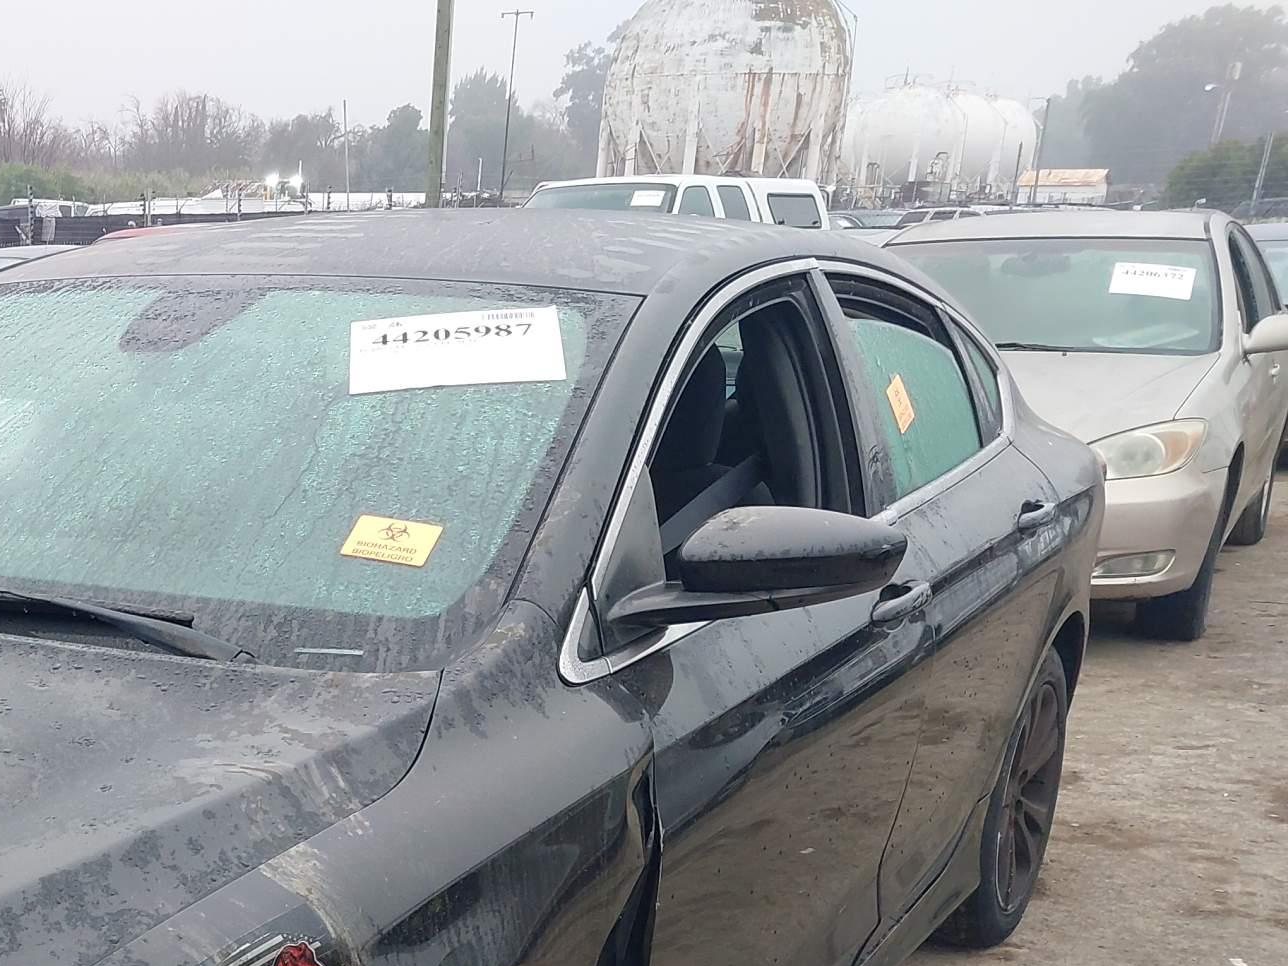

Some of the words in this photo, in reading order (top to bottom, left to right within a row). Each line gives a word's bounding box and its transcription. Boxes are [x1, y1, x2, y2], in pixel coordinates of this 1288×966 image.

[372, 322, 533, 346] 44205987
[351, 548, 414, 562] BIOPELIGRO
[356, 540, 417, 555] BIOHAZARD
